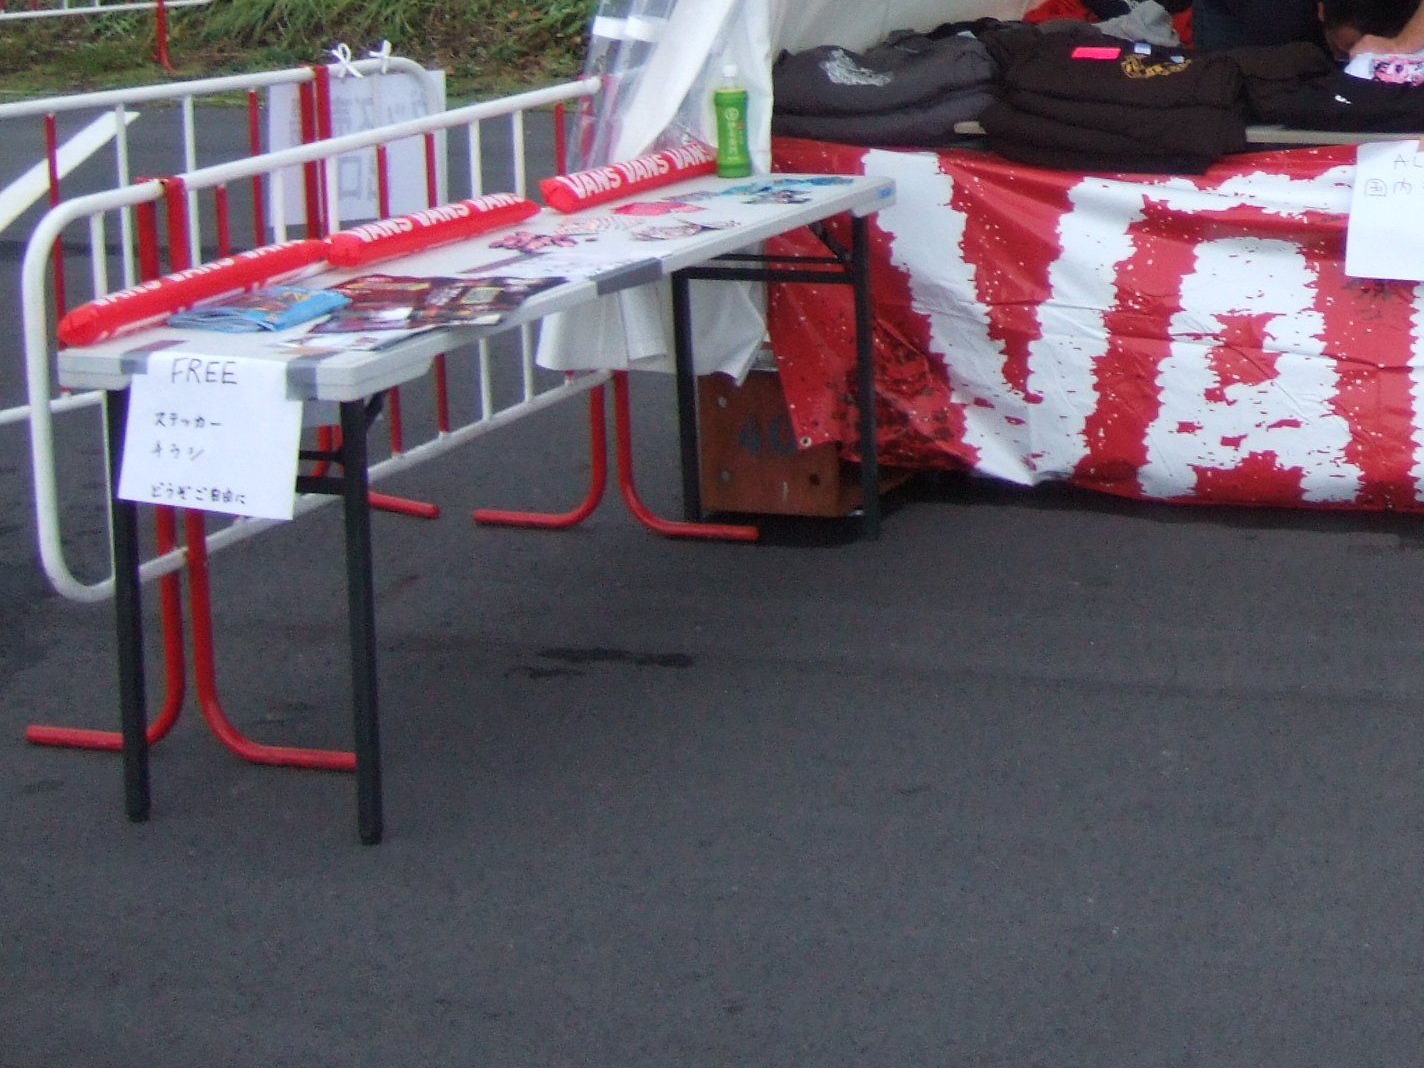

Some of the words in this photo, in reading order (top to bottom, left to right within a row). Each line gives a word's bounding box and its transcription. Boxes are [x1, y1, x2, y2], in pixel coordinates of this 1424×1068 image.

[555, 168, 622, 199] VANS
[611, 154, 670, 183] VANS
[171, 357, 238, 385] FREE
